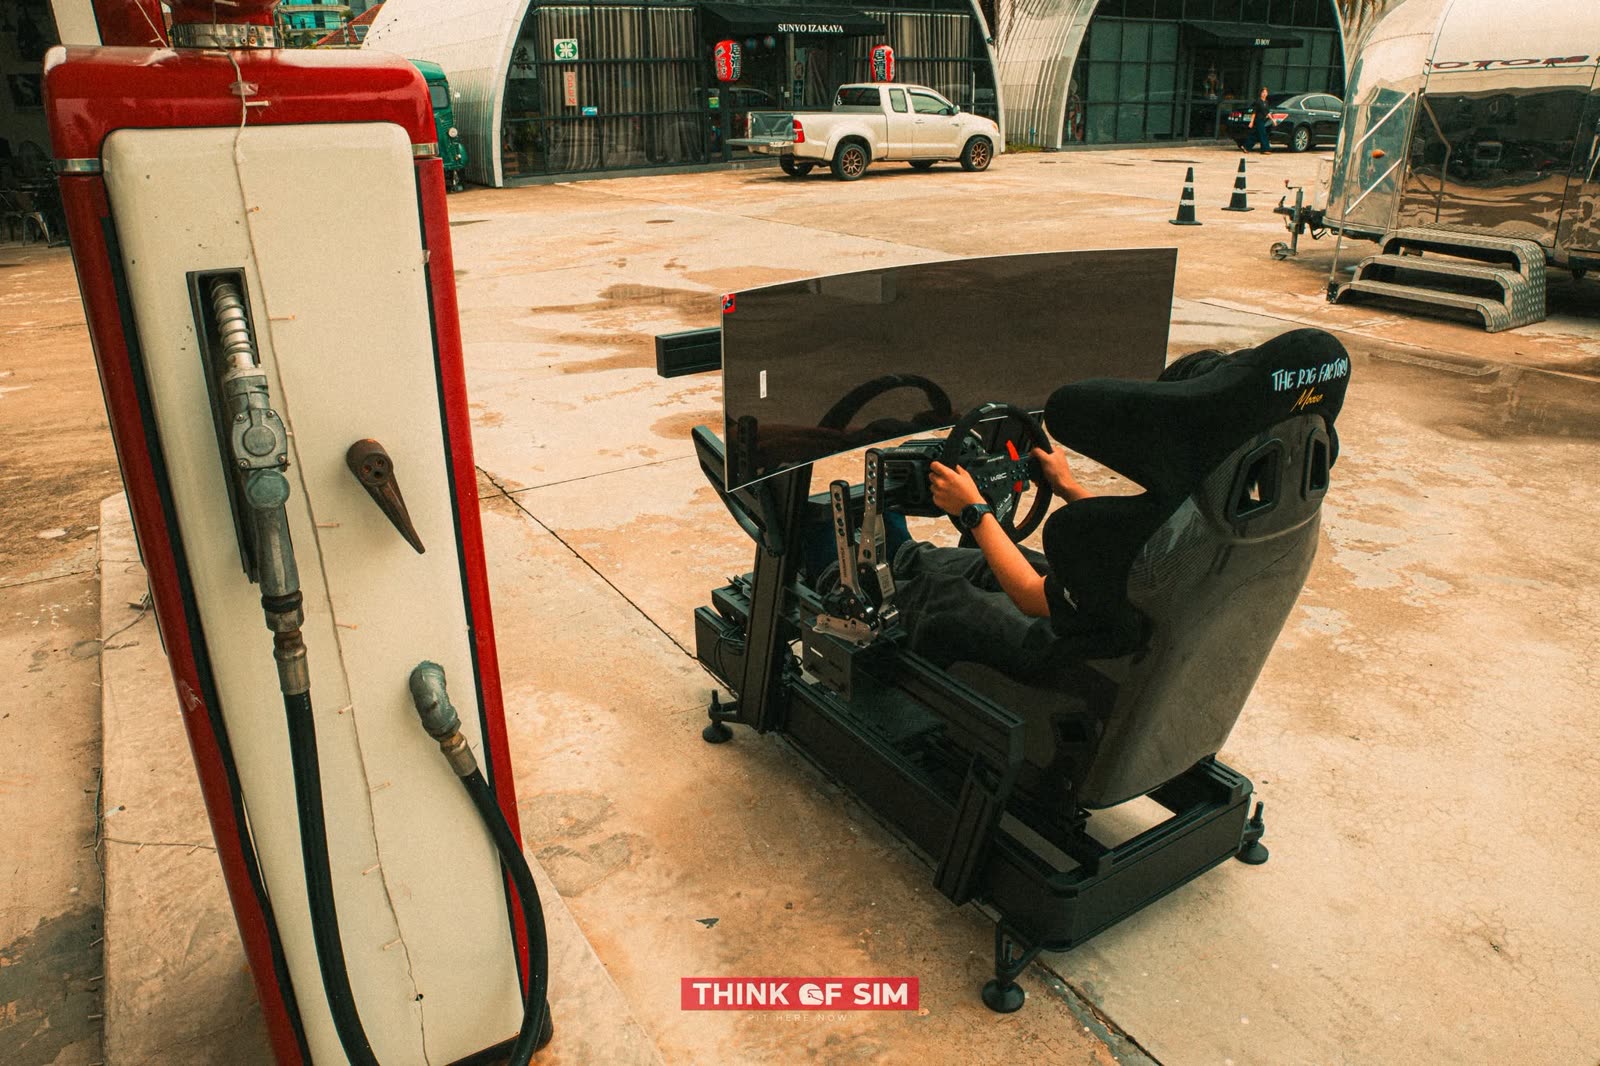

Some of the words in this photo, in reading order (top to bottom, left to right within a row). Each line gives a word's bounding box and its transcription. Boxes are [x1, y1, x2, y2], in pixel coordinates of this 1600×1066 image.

[777, 23, 807, 33] SUNYO
[808, 24, 844, 33] IZAKAYA
[1272, 369, 1296, 391] THE
[1296, 367, 1317, 388] RIG
[1318, 357, 1348, 383] FACTORY
